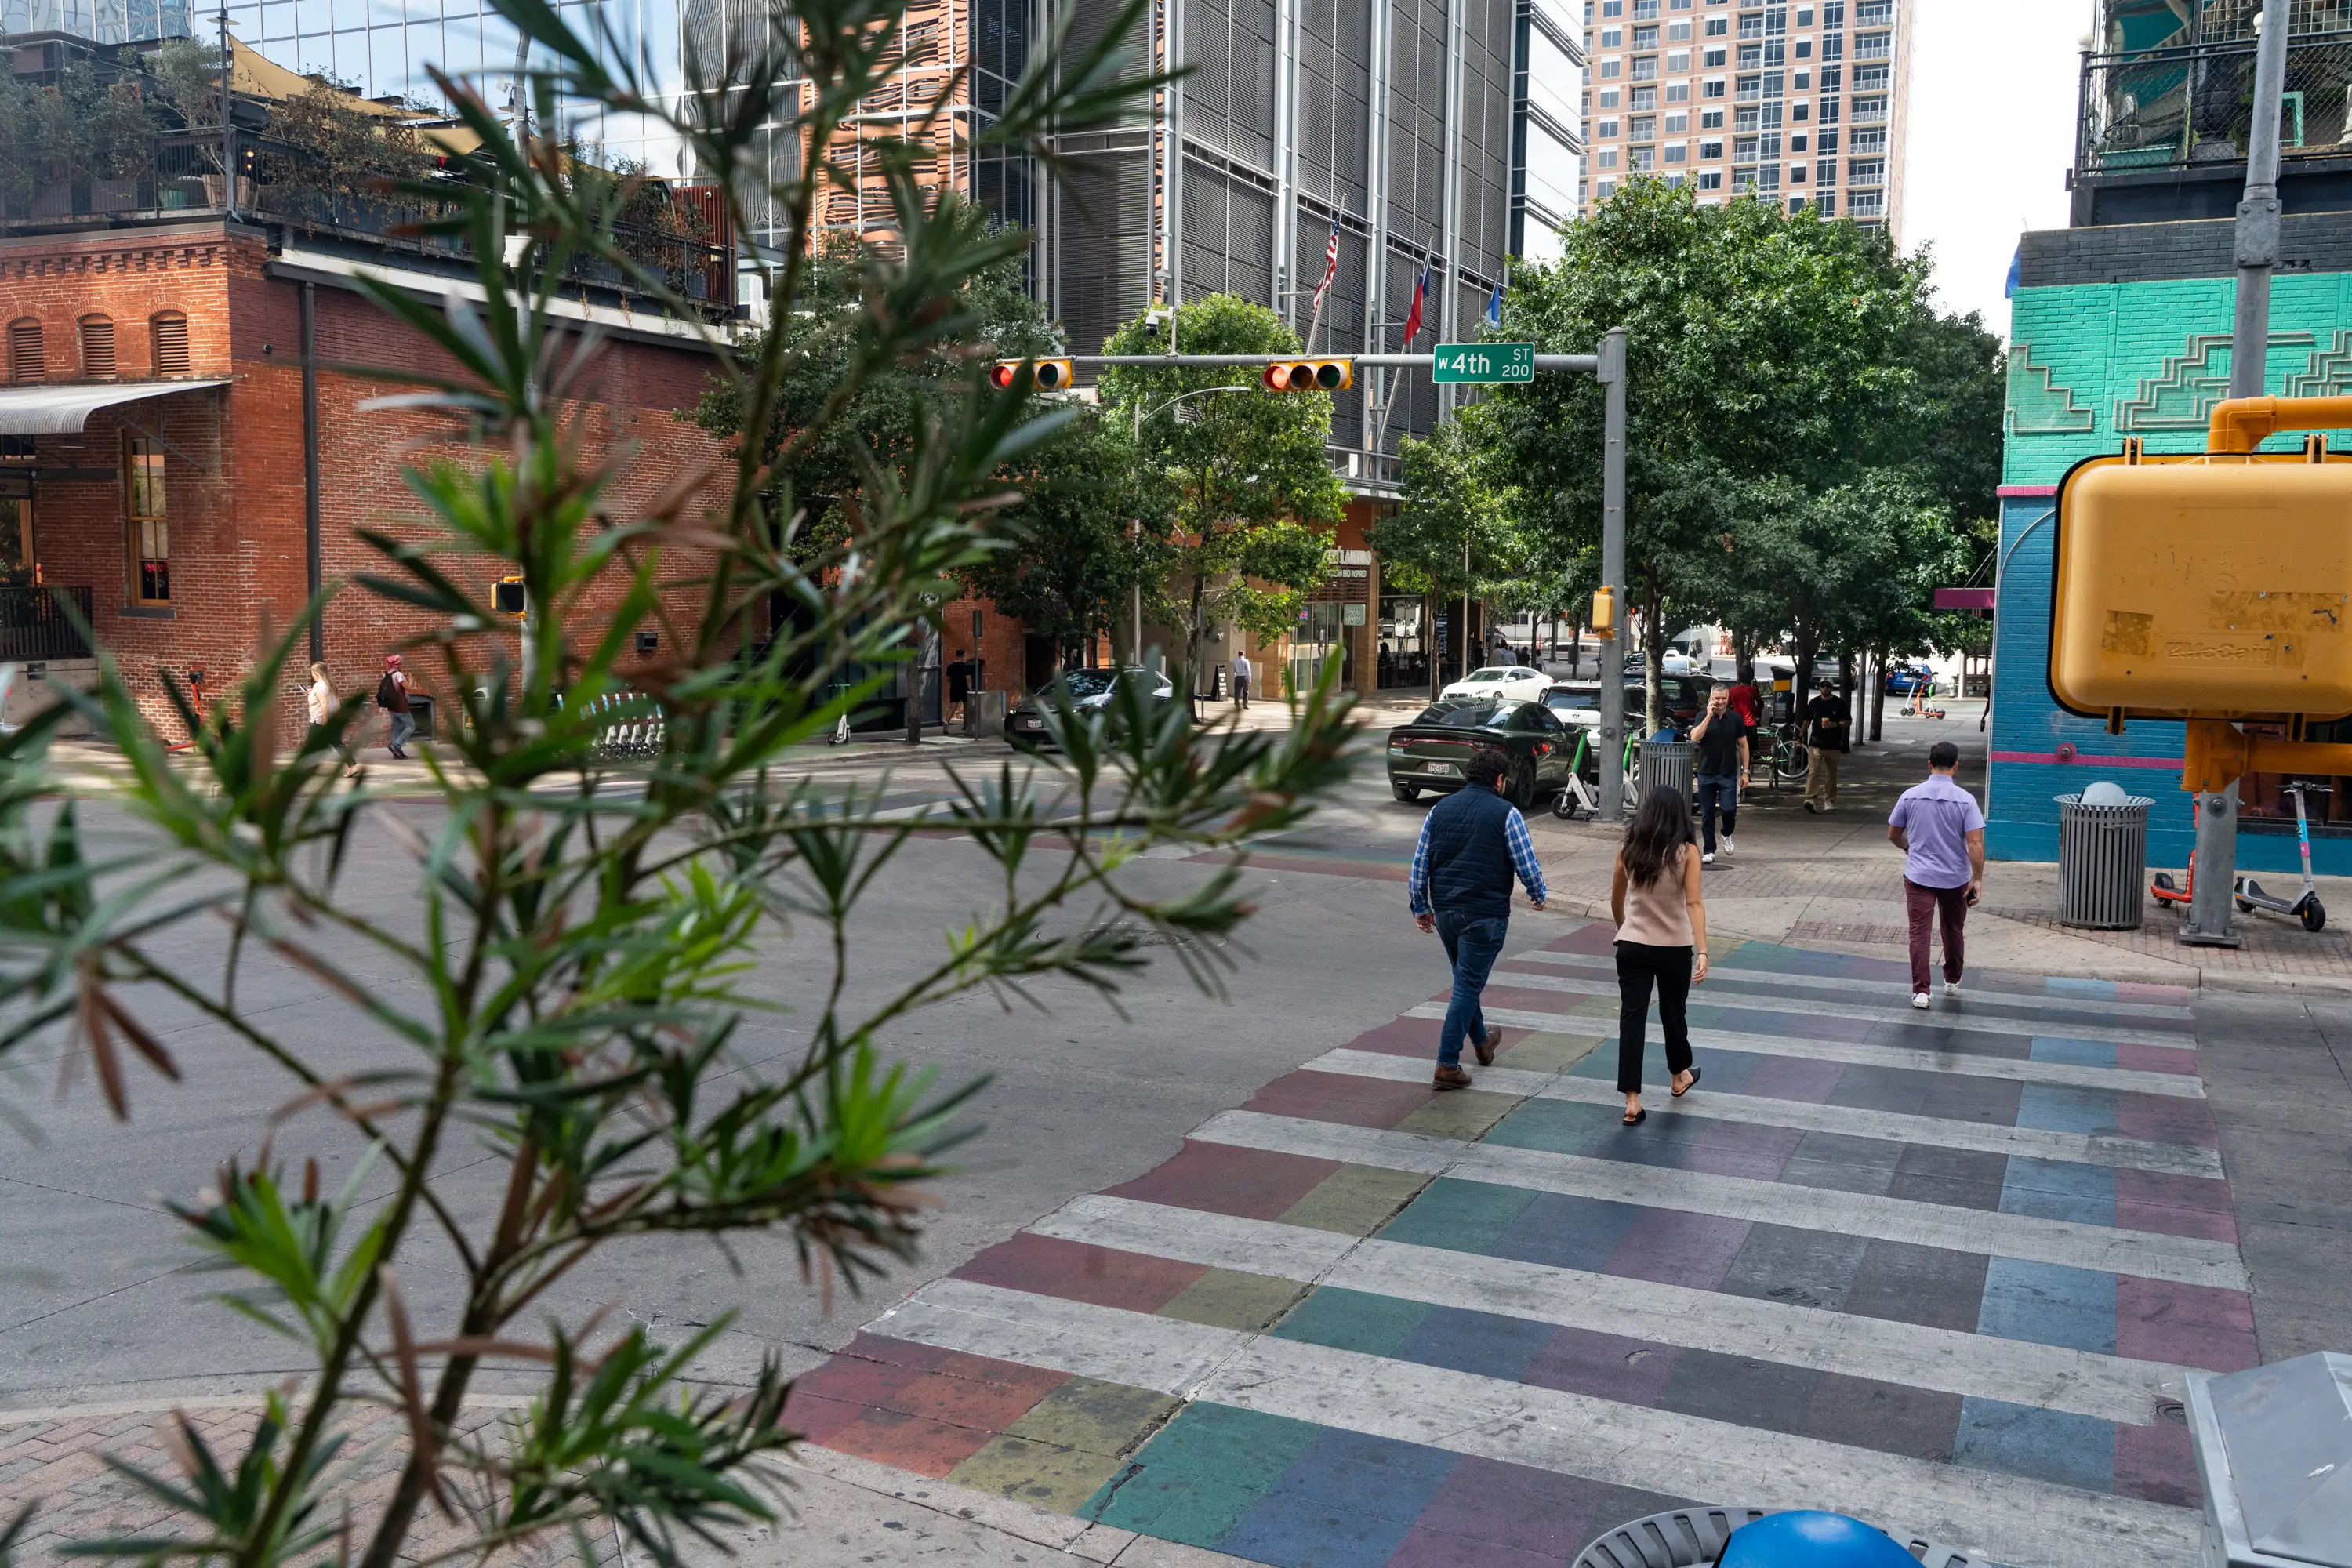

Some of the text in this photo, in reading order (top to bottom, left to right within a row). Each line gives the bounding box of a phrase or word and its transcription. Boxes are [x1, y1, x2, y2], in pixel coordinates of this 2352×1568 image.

[1513, 348, 1530, 361] ST
[1438, 353, 1490, 374] W 4th
[1502, 365, 1530, 377] 200
[1777, 691, 1783, 701] P
